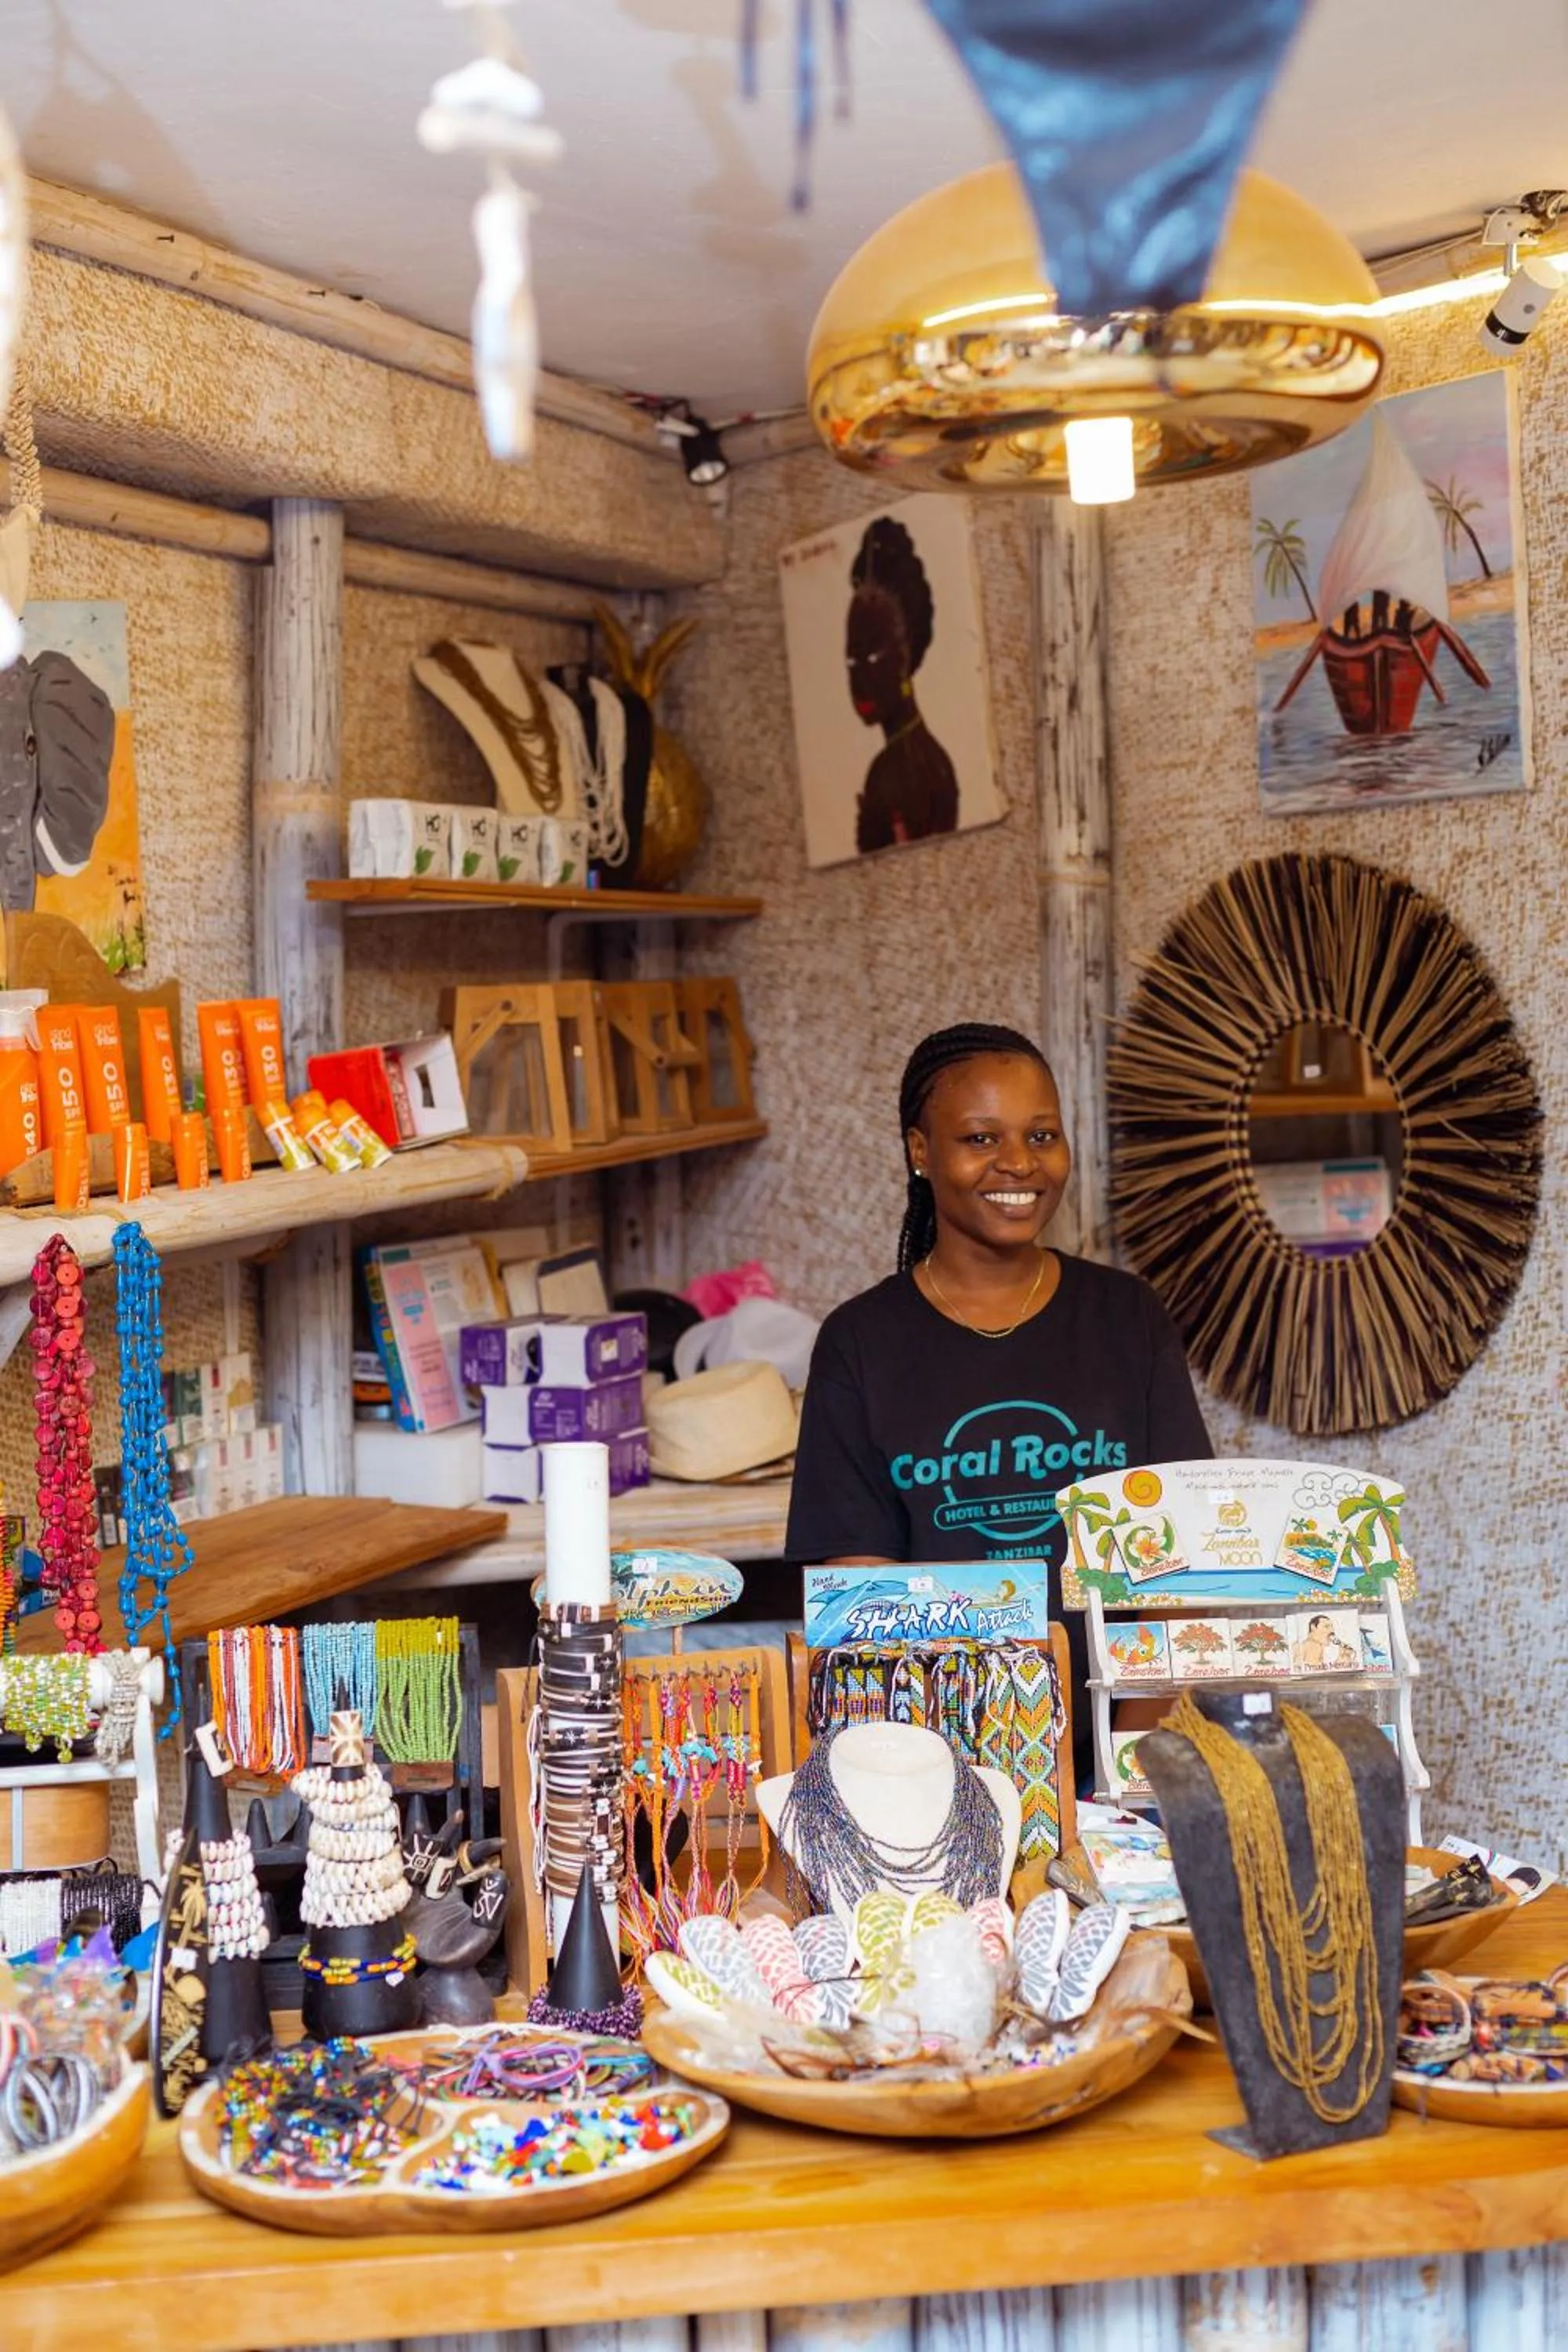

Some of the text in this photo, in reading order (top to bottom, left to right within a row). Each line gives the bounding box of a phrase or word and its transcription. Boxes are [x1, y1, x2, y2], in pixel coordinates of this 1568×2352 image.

[58, 1067, 79, 1107] 50
[103, 1062, 123, 1100] 50
[23, 1112, 36, 1143] 40
[891, 1430, 1127, 1490] Coral Rocks
[945, 1505, 987, 1522] HOTEL
[989, 1504, 1001, 1516] &
[846, 1598, 973, 1639] SHARK
